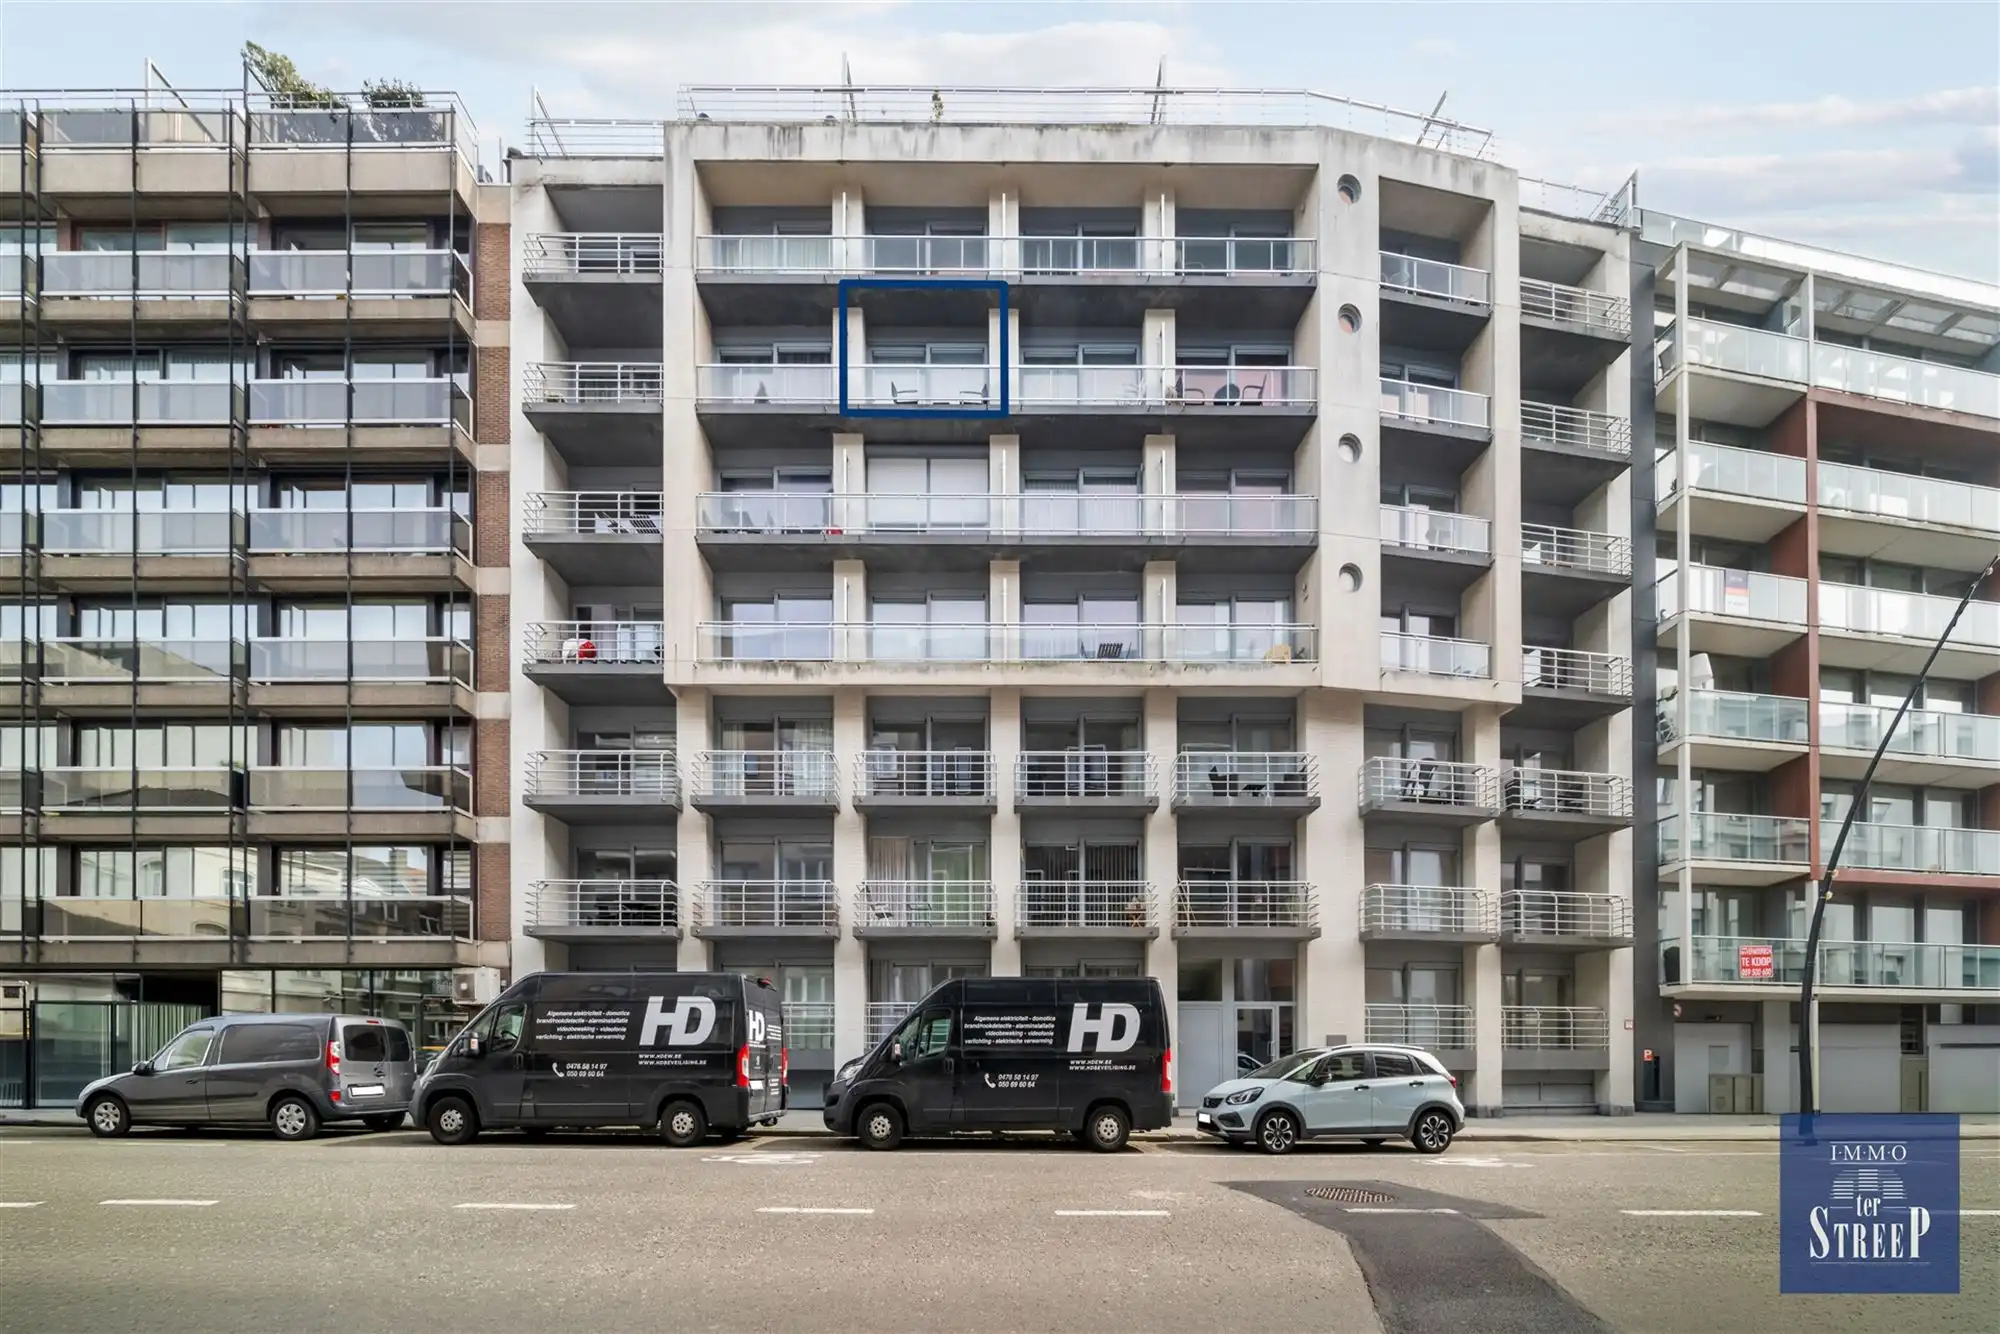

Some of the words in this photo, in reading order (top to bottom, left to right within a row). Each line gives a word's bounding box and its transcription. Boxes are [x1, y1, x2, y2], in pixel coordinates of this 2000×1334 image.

[1741, 957, 1750, 966] TE
[1751, 956, 1771, 966] KOOP
[546, 1010, 573, 1018] Algemene
[639, 996, 716, 1046] HD
[749, 1009, 765, 1042] HD
[1067, 1003, 1141, 1053] HD
[1643, 1049, 1653, 1061] P
